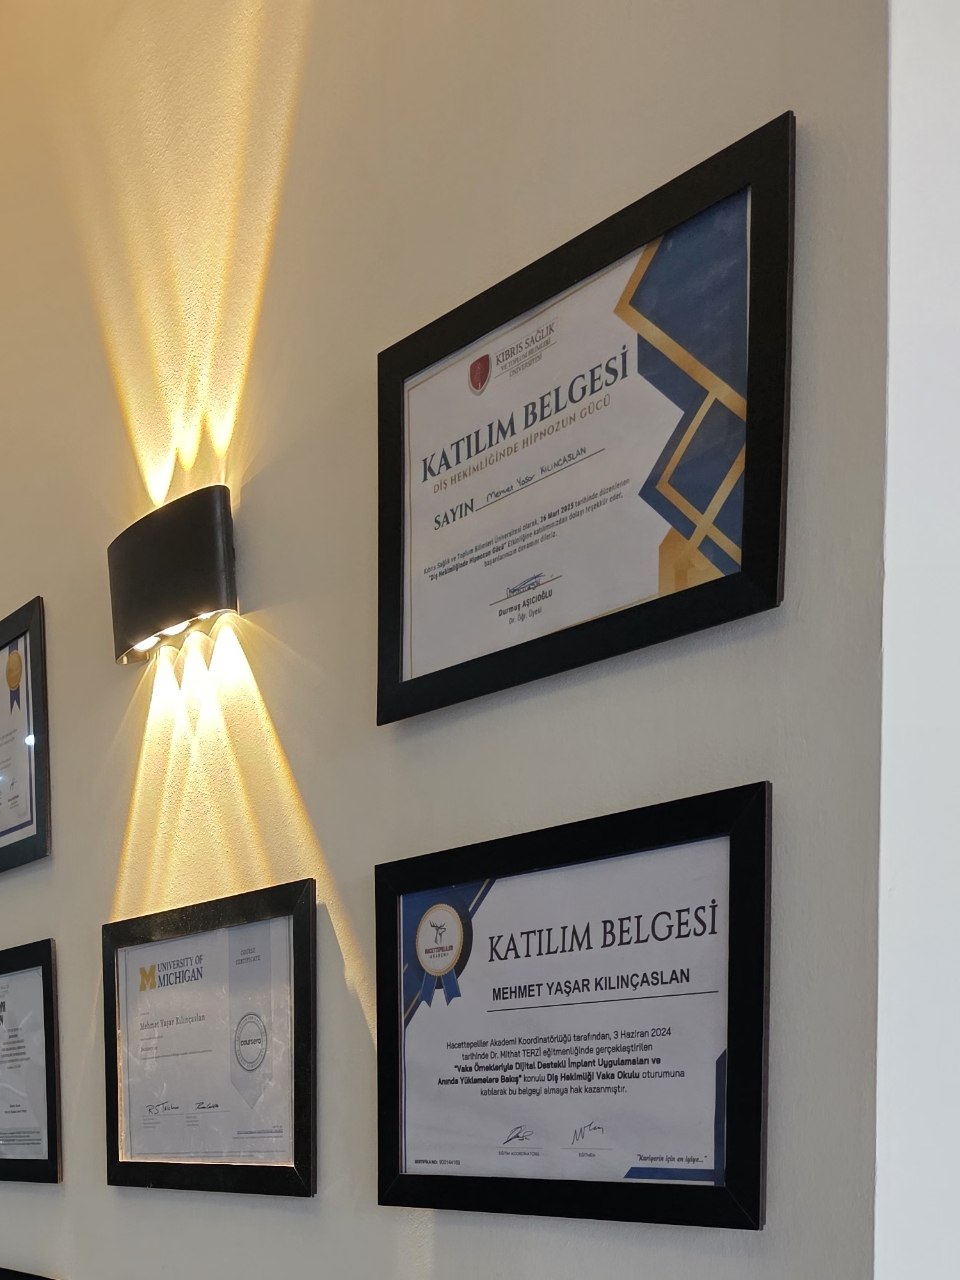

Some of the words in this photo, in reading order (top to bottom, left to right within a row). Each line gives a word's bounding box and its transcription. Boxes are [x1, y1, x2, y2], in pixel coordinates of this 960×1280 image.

[496, 343, 524, 366] KIBRIS
[525, 322, 556, 350] SAĞLIK
[421, 412, 517, 482] KATILIM
[523, 344, 629, 430] BELGESİ
[433, 477, 448, 494] DİŞ
[450, 443, 520, 486] HEKİMLİĞİNDE
[522, 412, 577, 449] HİPNOZUN
[579, 393, 611, 420] GÜCÜ
[433, 498, 475, 531] SAYIN
[498, 604, 521, 617] Durmuş
[522, 588, 553, 609] AŞICIOĞLU
[488, 922, 594, 963] KATILIM
[600, 898, 719, 949] BELGESİ
[157, 956, 194, 972] UNIVERSITY
[195, 954, 204, 964] OF
[157, 967, 204, 988] MICHIGAN
[492, 983, 543, 1001] MEHMET
[546, 978, 591, 998] YAŞAR
[594, 967, 690, 991] KILINÇASLAN
[446, 1040, 489, 1050] Hacettepeliler
[489, 1037, 517, 1047] Akademi
[518, 1033, 571, 1046] Koordinatörlüğü
[573, 1032, 612, 1042] tarafından,
[613, 1030, 619, 1039] 3
[620, 1029, 649, 1039] Haziran
[650, 1027, 672, 1037] 2024
[461, 1052, 489, 1061] tarihinde
[490, 1050, 499, 1060] Dr.
[500, 1049, 521, 1059] Mithat
[522, 1046, 541, 1058] TERZİ
[595, 1043, 653, 1056] gerçekleştirilen
[515, 1061, 536, 1072] Dijital
[537, 1059, 566, 1070] Destekli
[597, 1056, 650, 1068] Uygulamaları
[651, 1057, 662, 1065] ve
[546, 1073, 558, 1083] Diş
[560, 1071, 594, 1082] Hekimliği
[595, 1071, 615, 1081] Vaka
[616, 1070, 640, 1079] Okulu
[641, 1069, 685, 1079] oturumuna
[480, 1088, 508, 1096] katılarak
[508, 1087, 517, 1096] bu
[543, 1086, 569, 1097] almaya
[569, 1085, 583, 1094] hak
[584, 1084, 627, 1095] kazanmıştır.
